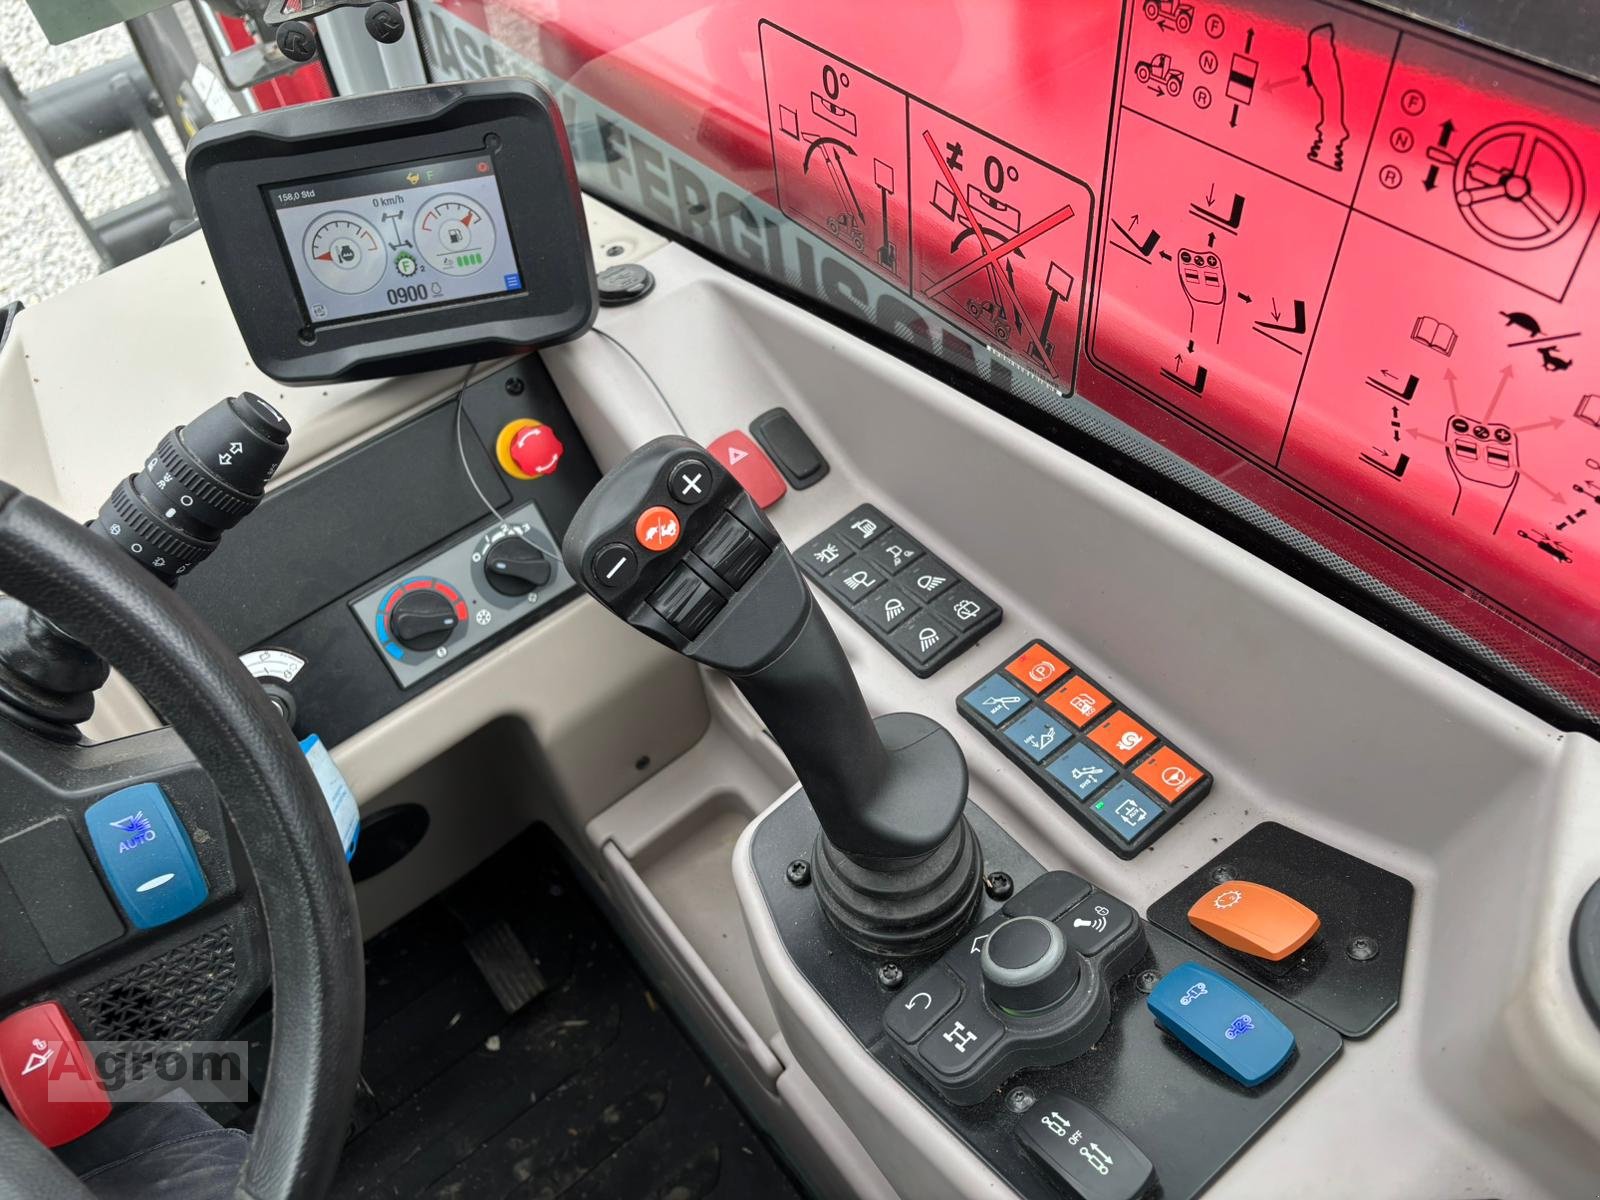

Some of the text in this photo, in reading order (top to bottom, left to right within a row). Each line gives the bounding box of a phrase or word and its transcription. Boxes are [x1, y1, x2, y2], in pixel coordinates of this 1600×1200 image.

[425, 170, 434, 182] F
[277, 189, 316, 203] 158,0 Std
[372, 194, 405, 208] 0 km/h
[401, 260, 412, 273] F
[386, 283, 429, 306] 0900
[119, 829, 156, 853] AUTO
[1068, 1129, 1083, 1146] OFF
